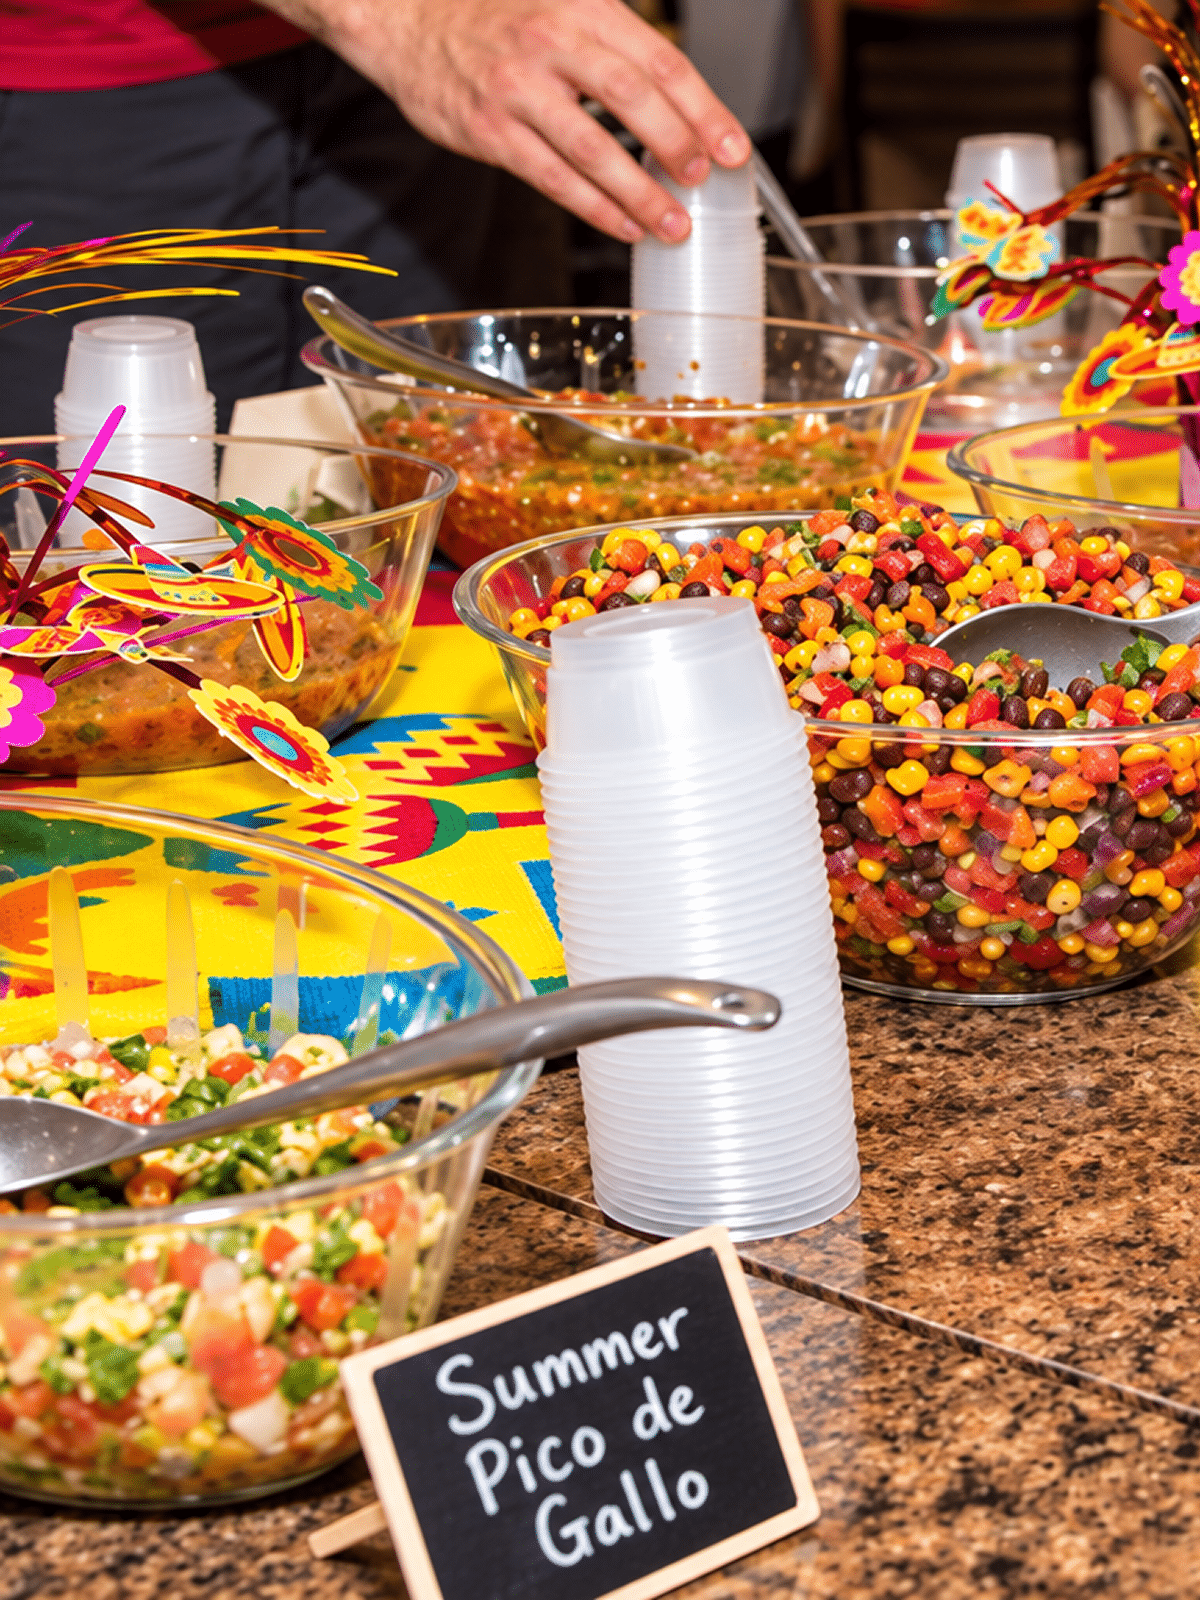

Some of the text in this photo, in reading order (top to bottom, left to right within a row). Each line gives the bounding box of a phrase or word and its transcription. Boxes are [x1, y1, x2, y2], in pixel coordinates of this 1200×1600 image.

[435, 1306, 690, 1436] Summer
[464, 1375, 706, 1516] Pico de
[534, 1457, 711, 1568] Gallo
